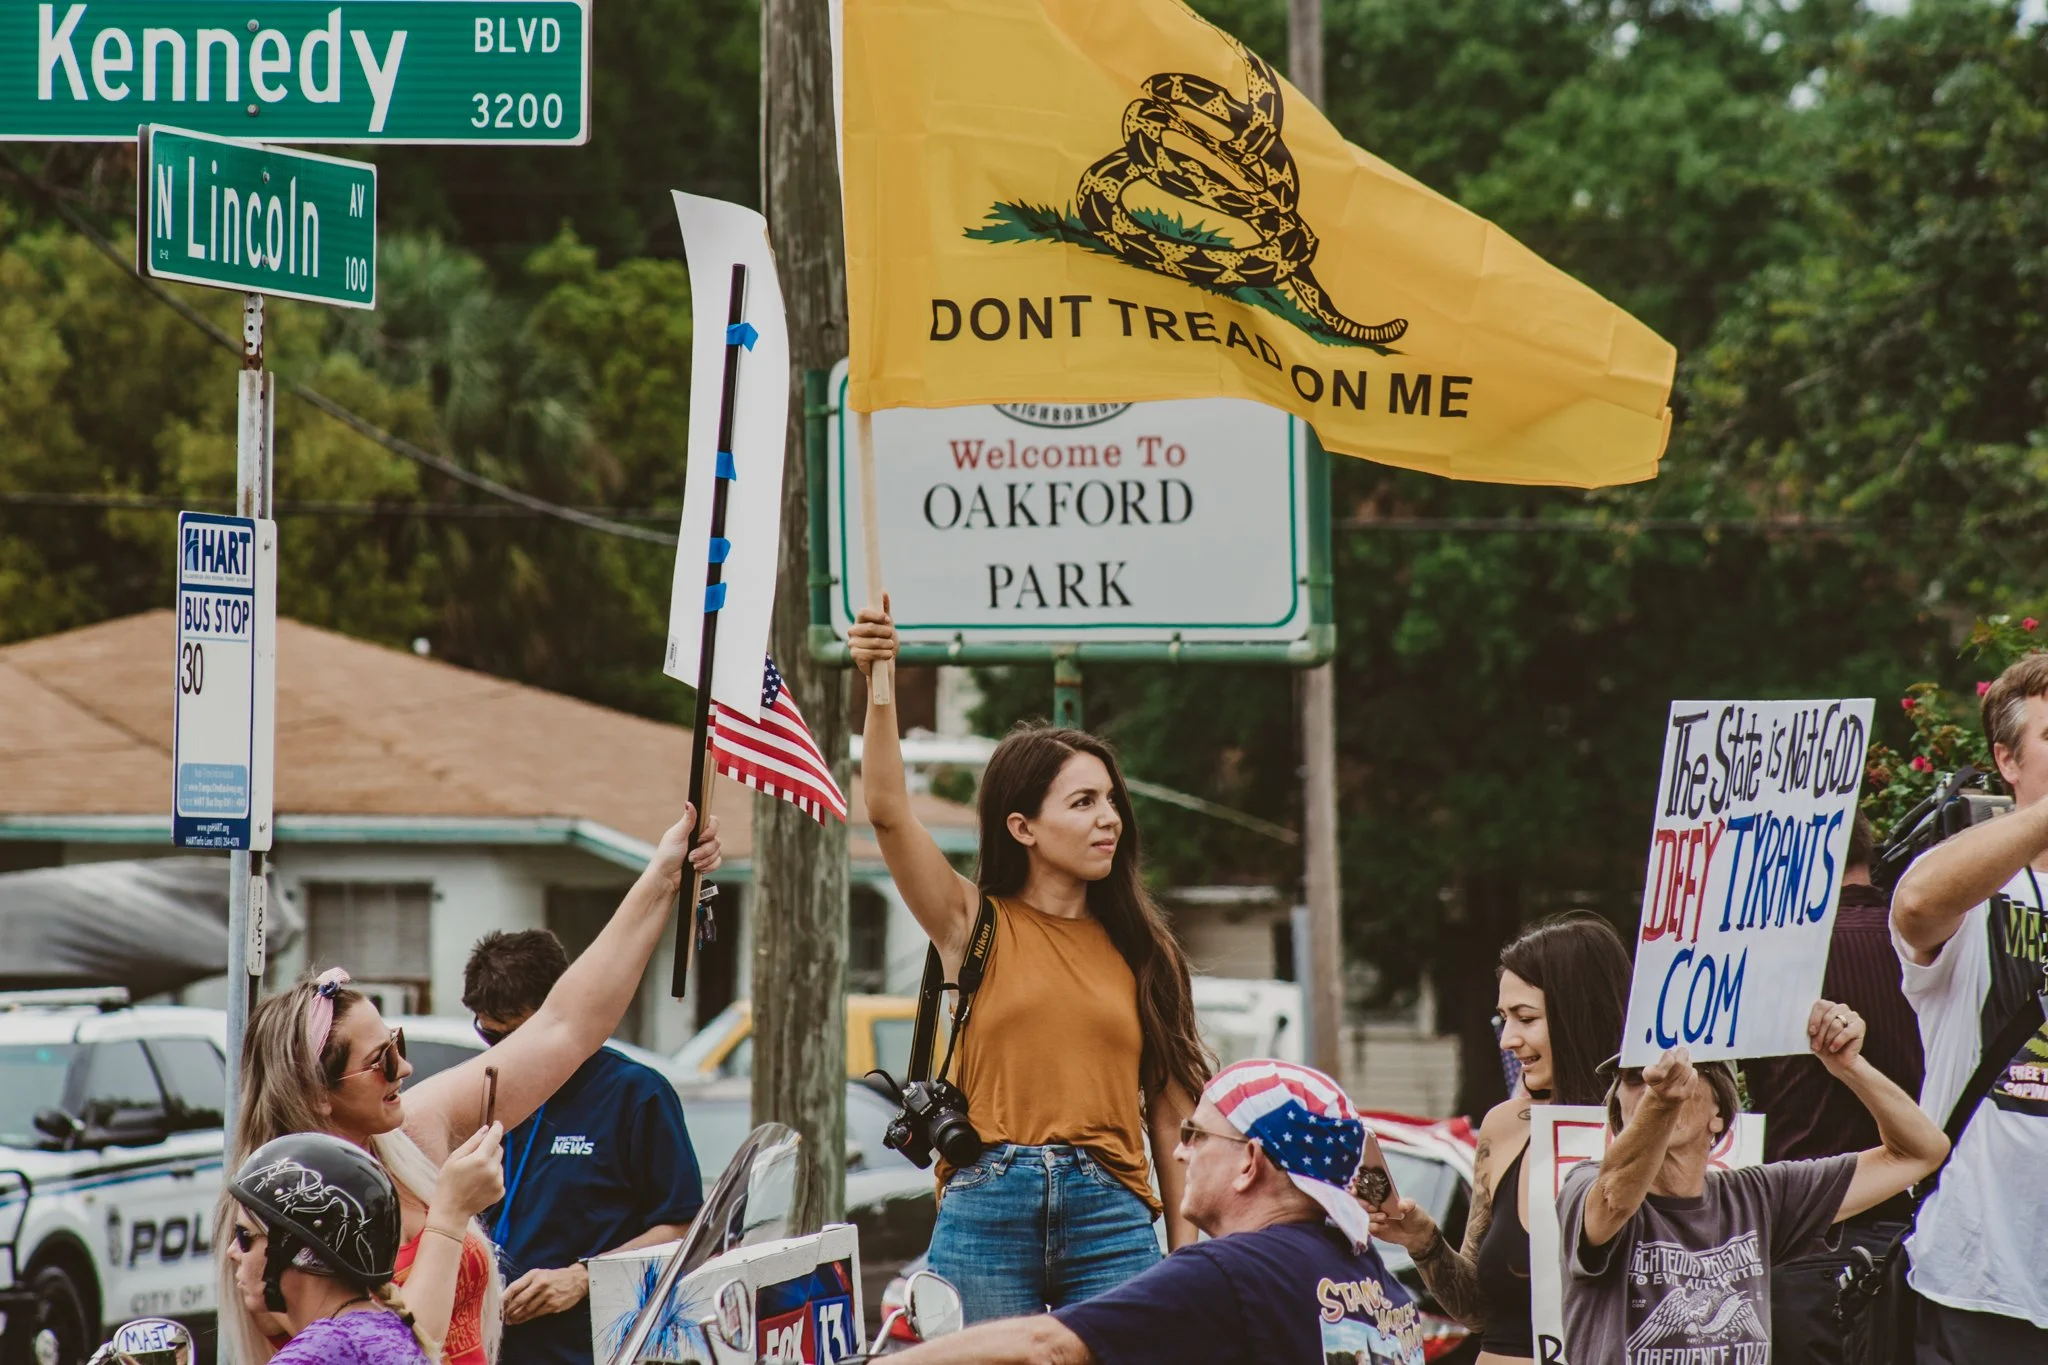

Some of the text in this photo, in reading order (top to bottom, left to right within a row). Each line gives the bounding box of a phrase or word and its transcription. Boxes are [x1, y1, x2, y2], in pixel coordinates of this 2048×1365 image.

[474, 18, 561, 53] BLVD
[38, 4, 407, 132] Kennedy
[471, 93, 563, 129] 3200
[157, 156, 365, 278] N Lincoln AV
[345, 256, 367, 293] 100
[930, 295, 1473, 418] DONT TREAD ON ME
[949, 436, 1187, 470] Welcome To
[924, 478, 1194, 530] OAKFORD
[202, 528, 251, 576] HART
[986, 561, 1133, 609] PARK
[185, 596, 249, 634] BUS STOP
[181, 642, 203, 695] 30
[1665, 710, 1709, 820] The
[1710, 703, 1763, 814] State
[1765, 718, 1786, 779] is
[1642, 806, 1844, 944] DEFY TYRANTS
[974, 923, 991, 959] Nikon
[1646, 945, 1747, 1049] .COM
[550, 1141, 595, 1155] NEWS
[1653, 1272, 1682, 1287] EVIL
[819, 1303, 848, 1365] 13
[1637, 1344, 1730, 1365] OBEDIENCE
